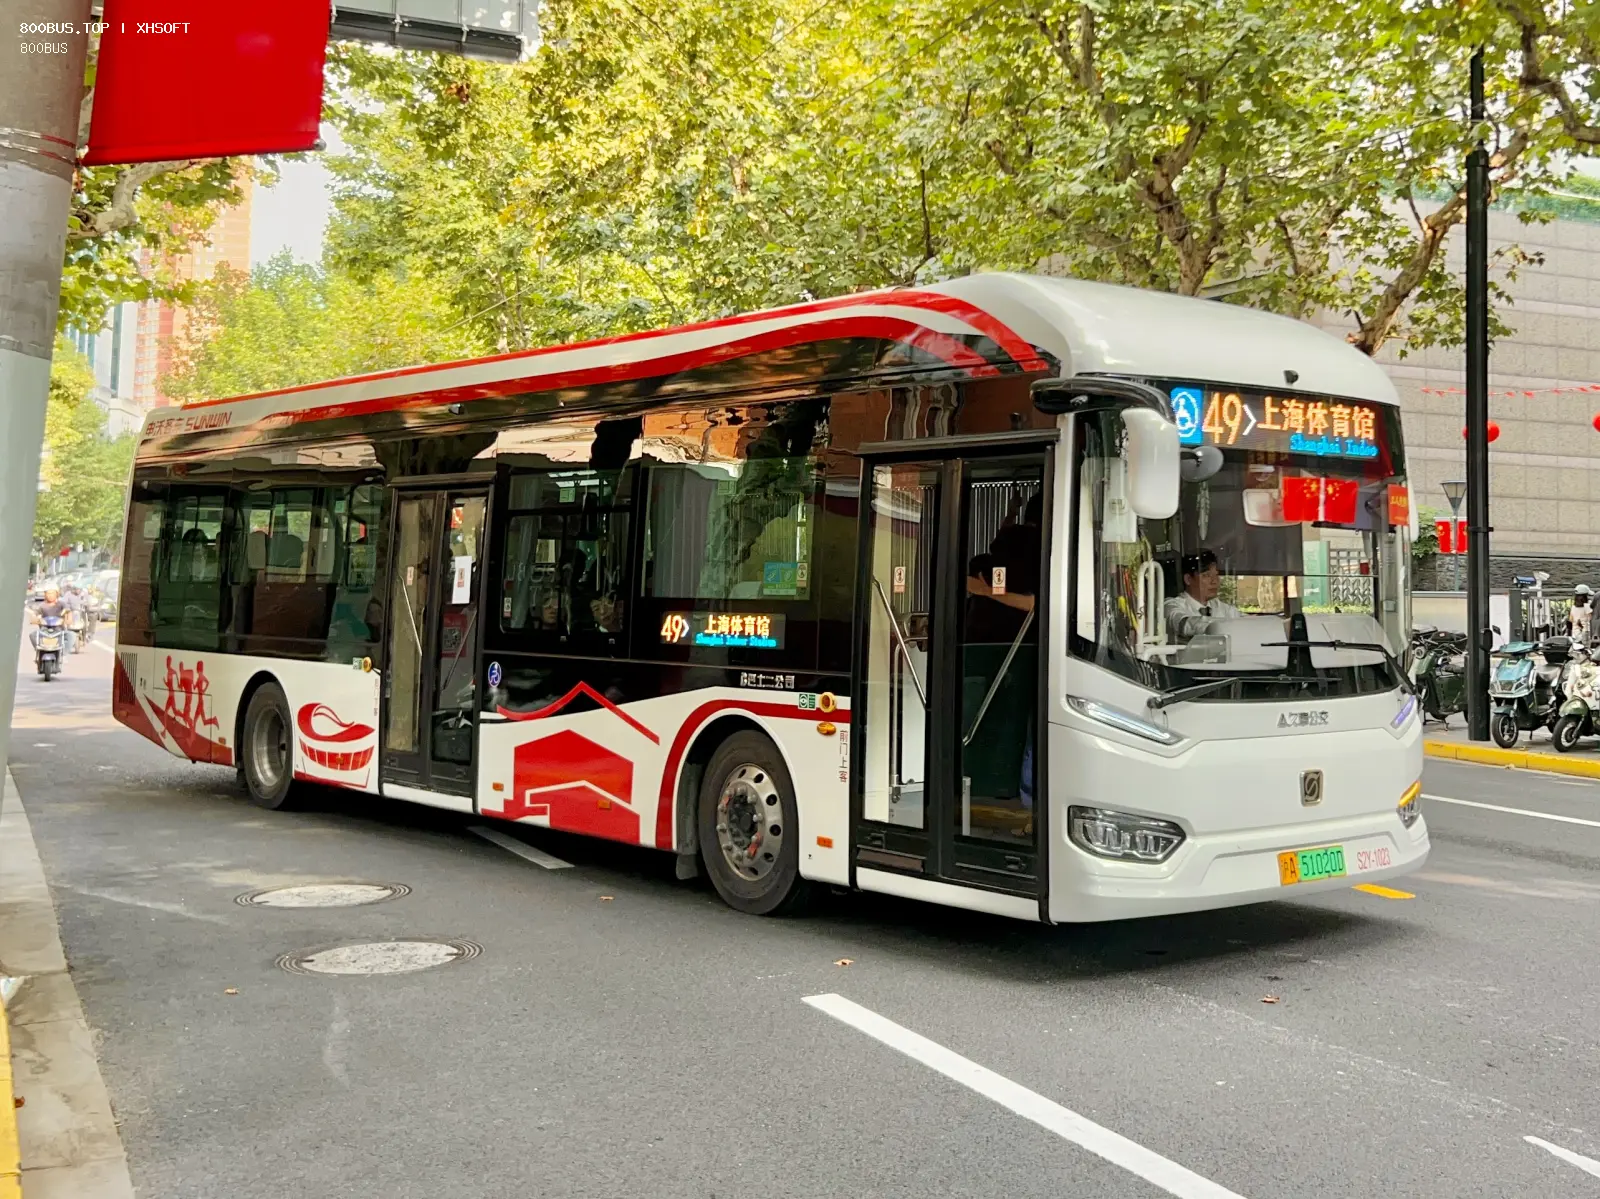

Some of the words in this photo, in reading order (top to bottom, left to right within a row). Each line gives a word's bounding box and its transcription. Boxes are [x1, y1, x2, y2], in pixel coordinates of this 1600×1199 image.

[184, 411, 232, 432] SUNWIN
[1202, 391, 1242, 445] 49
[1256, 395, 1376, 441] 上海体育馆
[1290, 433, 1341, 456] Shanghai
[660, 614, 682, 643] 49
[704, 614, 771, 637] 上海体育馆
